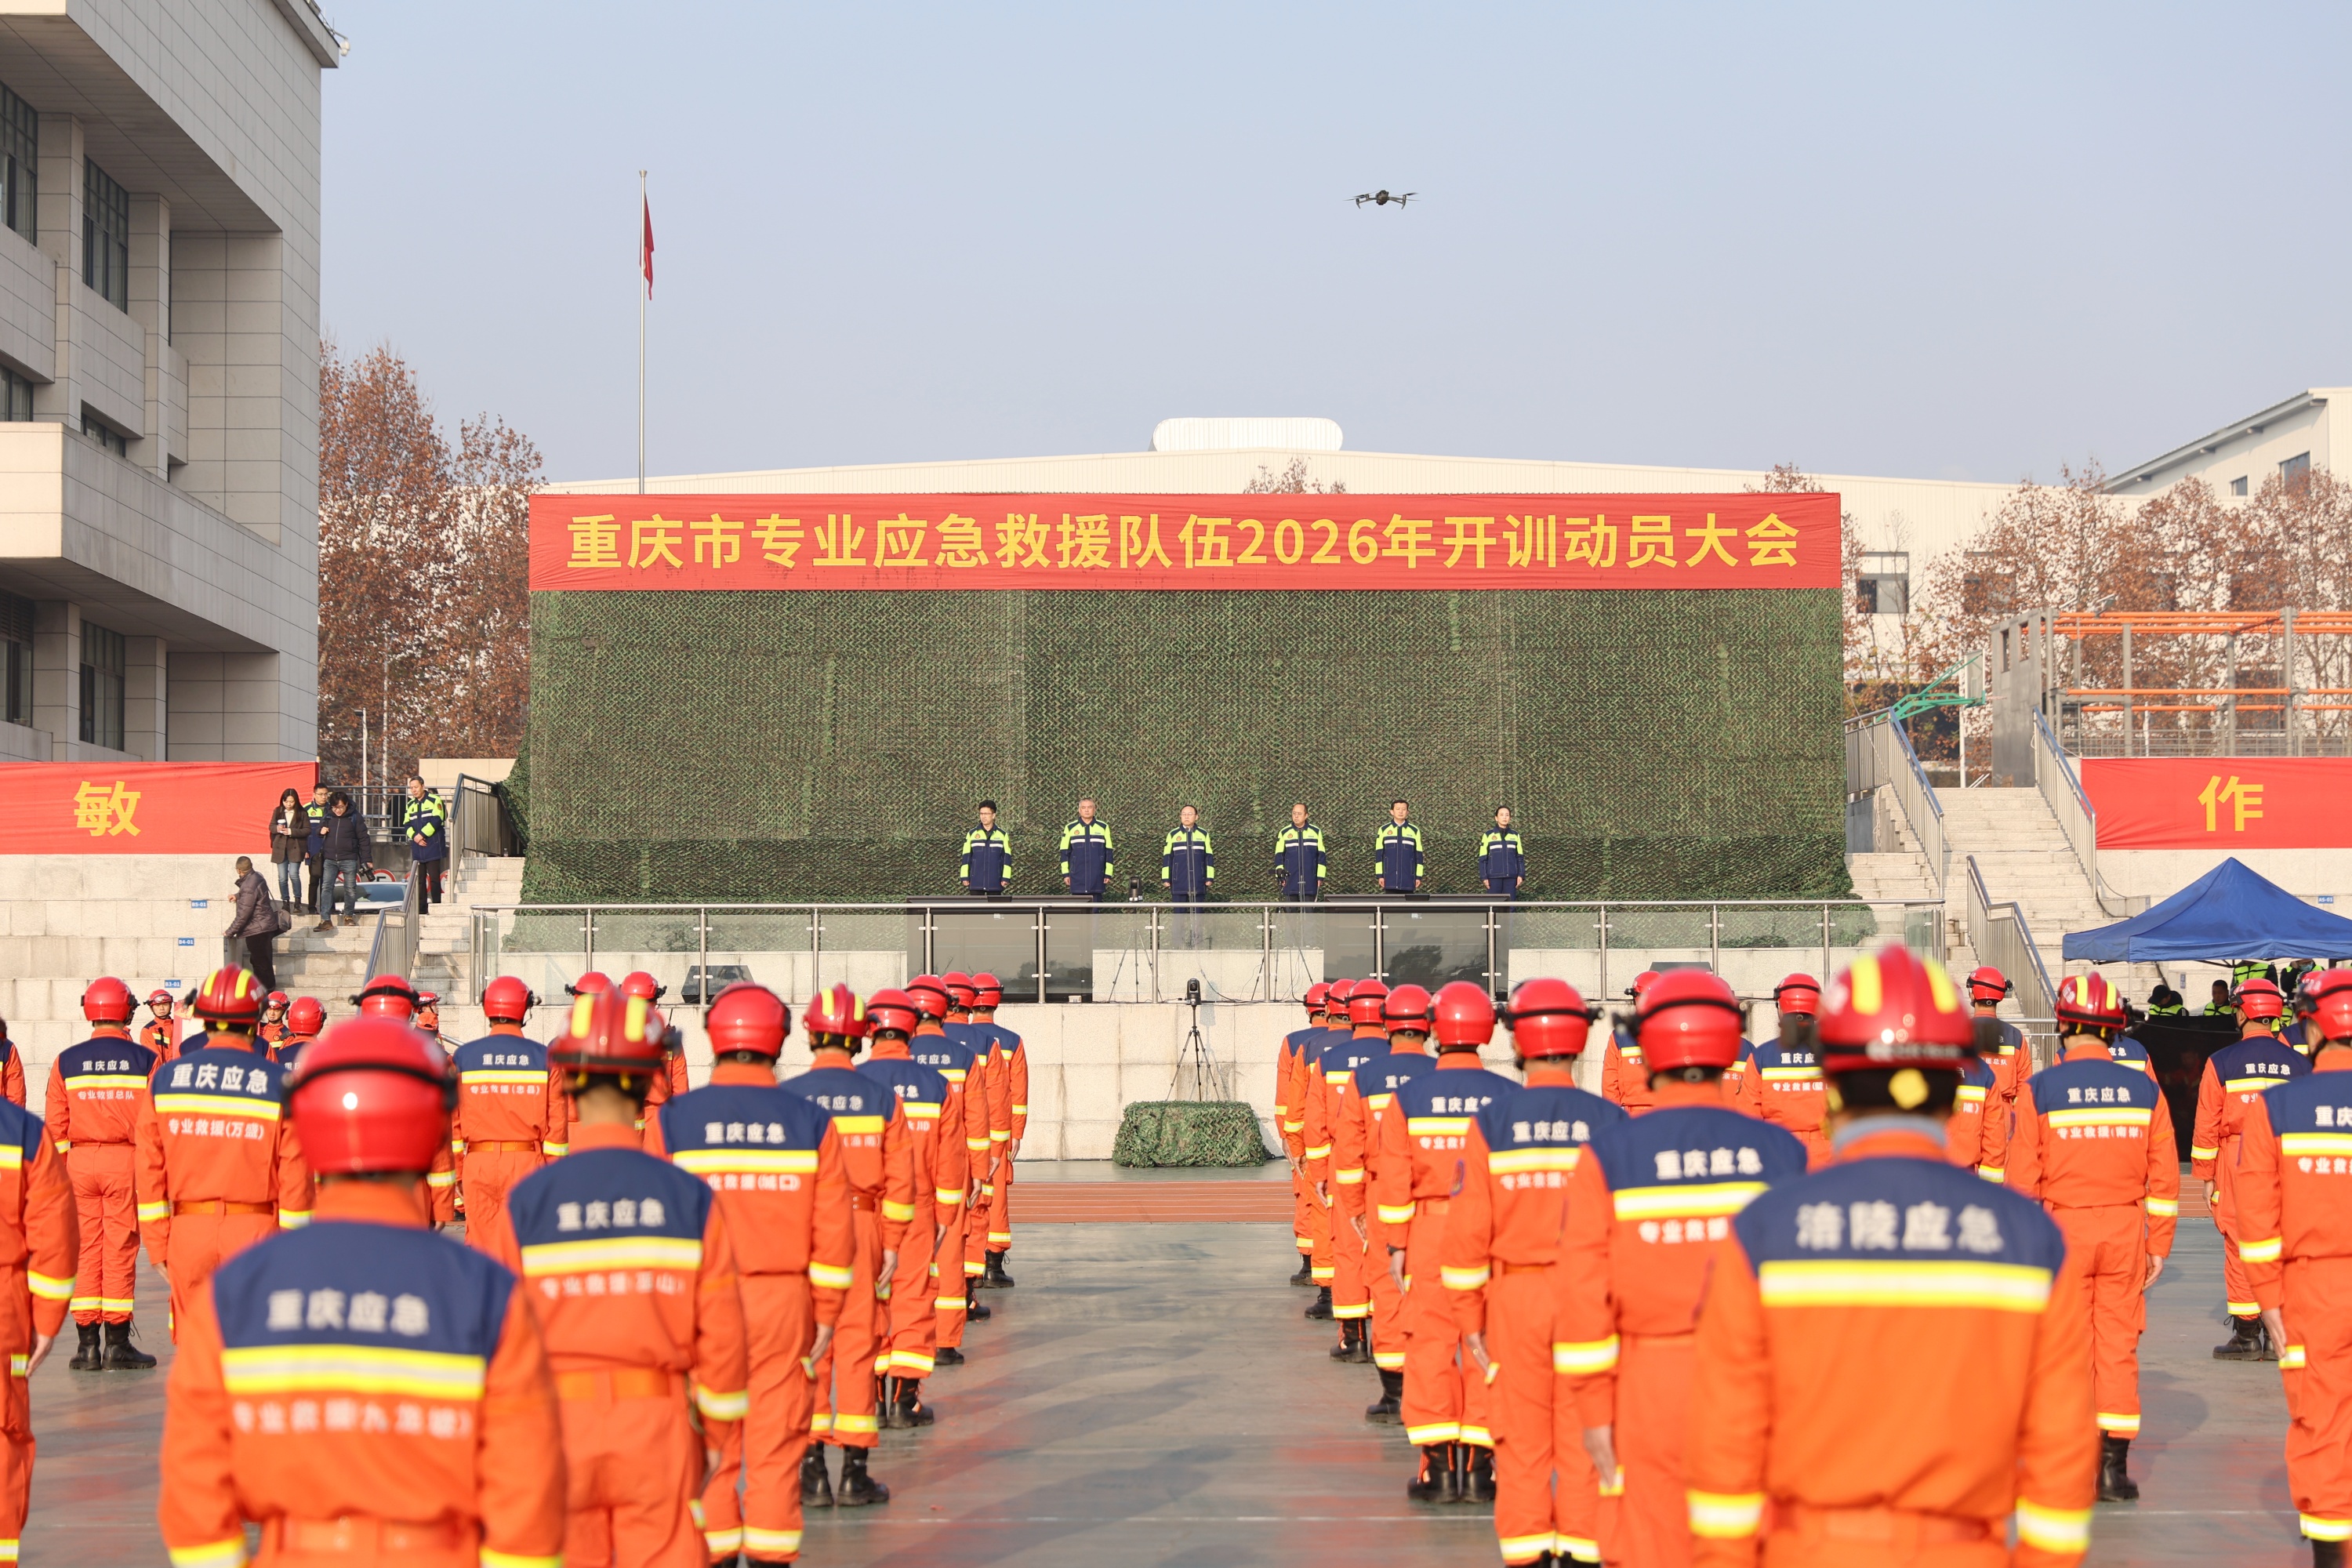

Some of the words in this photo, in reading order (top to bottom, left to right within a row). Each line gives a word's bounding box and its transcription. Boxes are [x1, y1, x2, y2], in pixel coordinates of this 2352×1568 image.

[567, 513, 1799, 568] 重庆市专业应急救援队伍2026年开训动员大会
[74, 781, 141, 837] 敏
[2198, 775, 2263, 832] 作
[82, 1059, 130, 1072] 重庆应急
[482, 1053, 529, 1065] 重庆应急
[909, 1054, 951, 1065] 庆应急
[2245, 1062, 2291, 1076] 重庆应急
[170, 1062, 268, 1095] 重庆应急
[78, 1090, 134, 1100] 专业救援总队
[2067, 1087, 2131, 1104] 重庆应急
[168, 1117, 265, 1141] 专业救援(万盛)
[704, 1121, 786, 1145] 重庆应急
[1512, 1120, 1592, 1143] 重庆应急
[2056, 1125, 2143, 1141] 专业救援(南岸)
[1653, 1146, 1764, 1181] 重庆应急
[2297, 1156, 2352, 1175] 专业救
[556, 1196, 666, 1232] 重庆应急
[1795, 1200, 2005, 1254] 涪陵应急
[266, 1287, 430, 1338] 重庆应急
